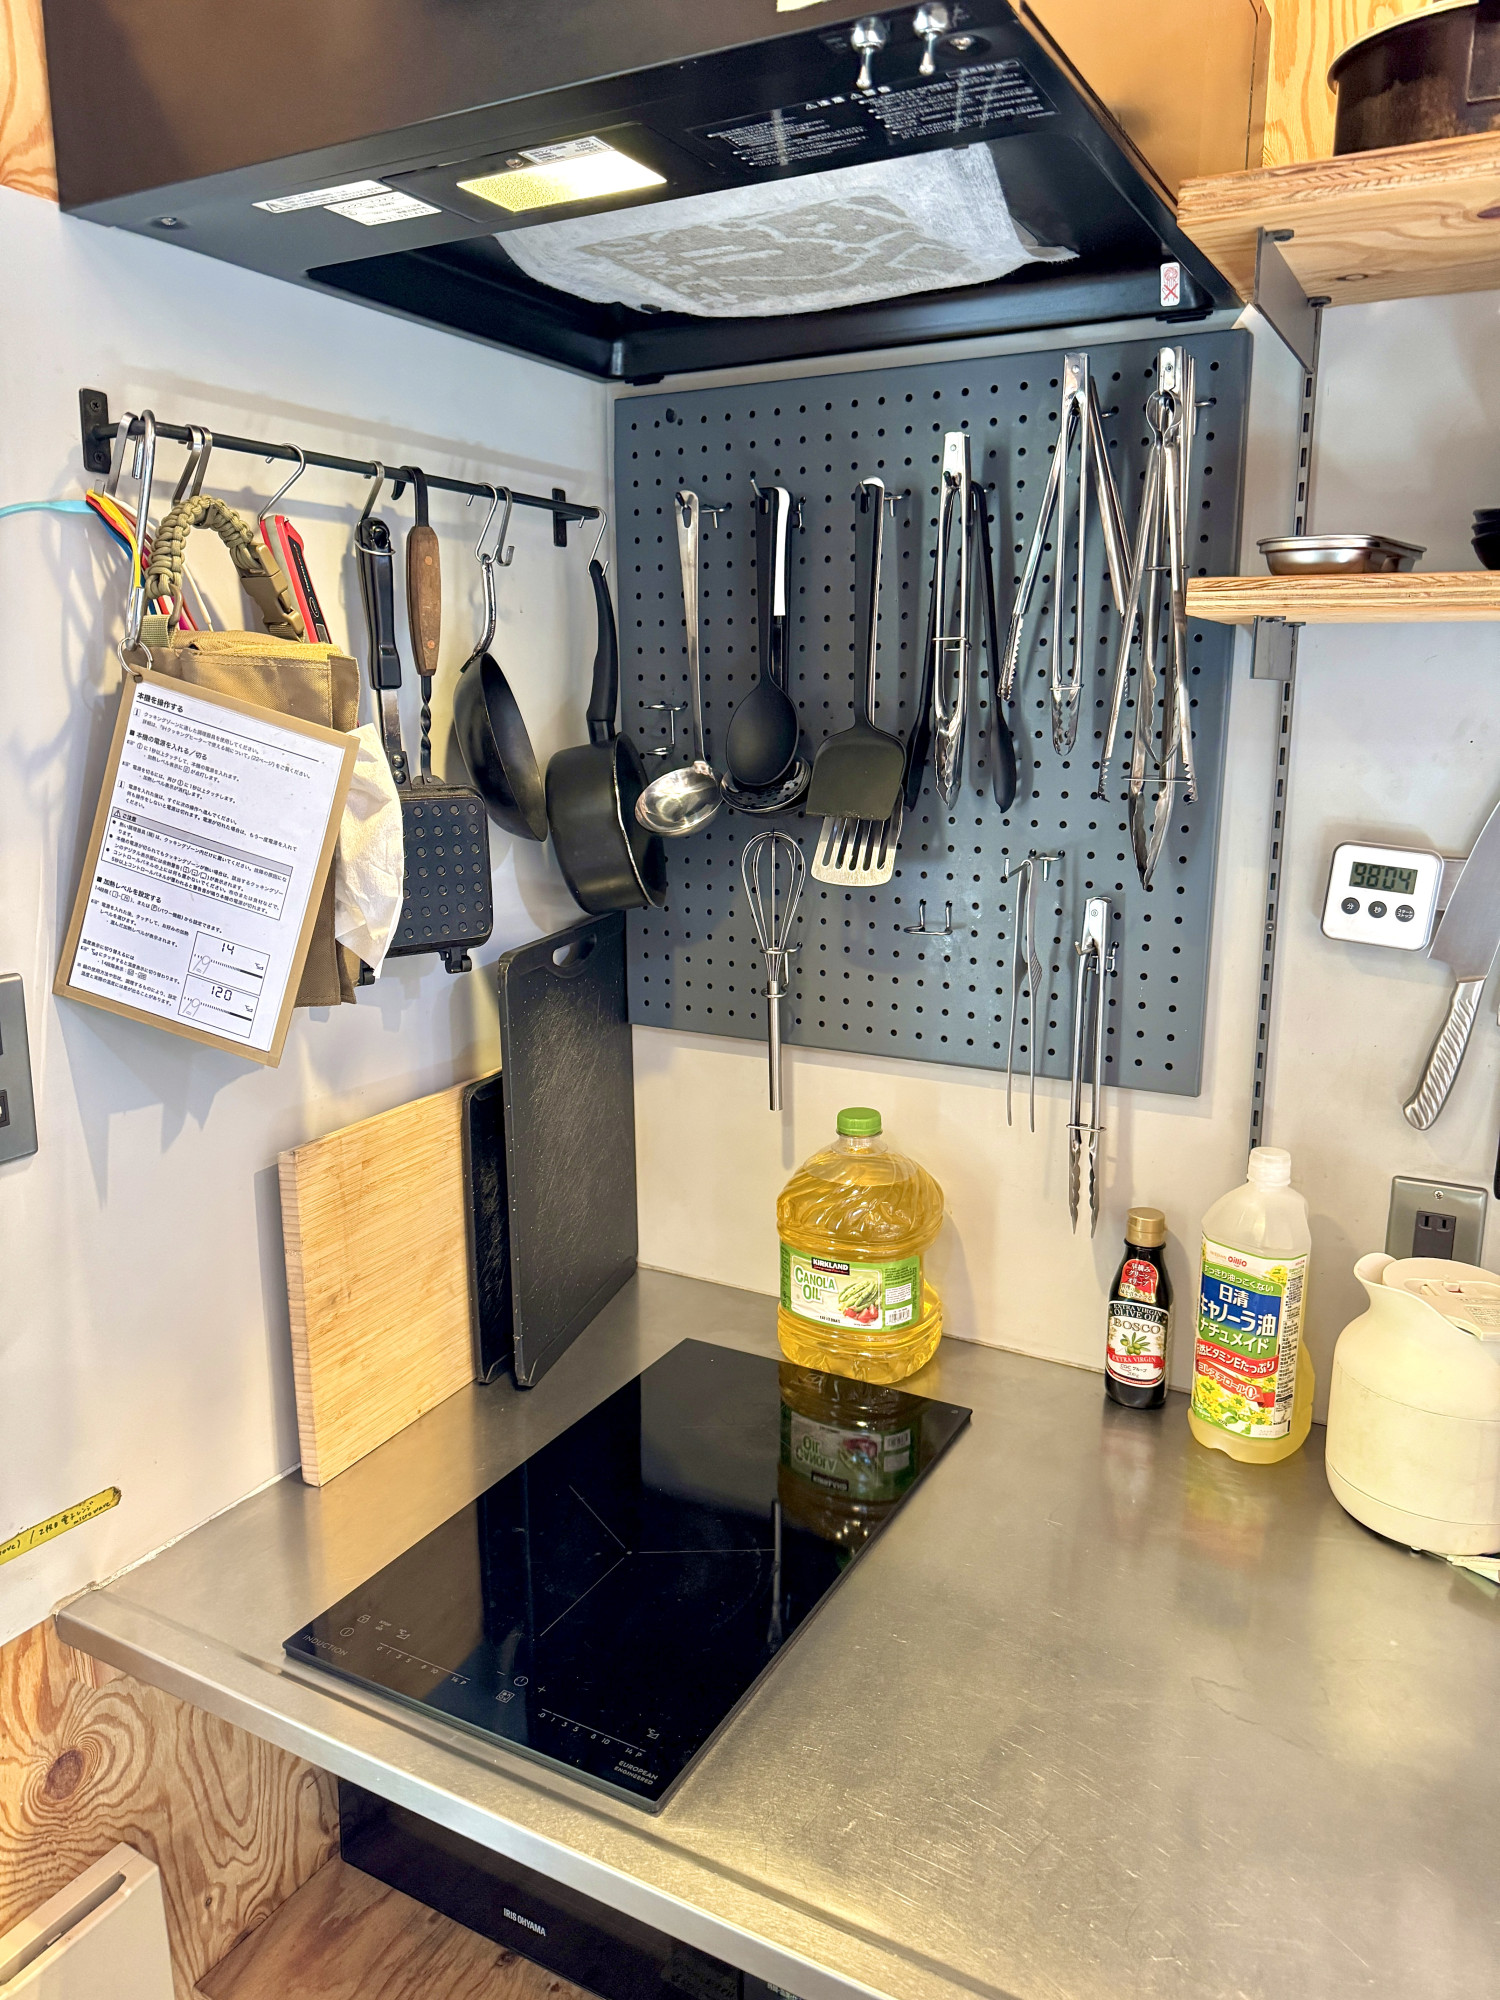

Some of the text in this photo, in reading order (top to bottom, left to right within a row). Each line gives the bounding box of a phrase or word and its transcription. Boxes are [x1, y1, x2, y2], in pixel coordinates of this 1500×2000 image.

[136, 691, 184, 713] 本機を操作する
[124, 798, 145, 809] ください。
[122, 813, 136, 822] ご注意
[102, 878, 162, 904] 加熱レベルを設定する
[221, 942, 234, 955] 14
[210, 984, 233, 1002] 120
[812, 1258, 848, 1271] KIRKLAND
[795, 1267, 836, 1290] CANOLA
[1204, 1265, 1274, 1292] すっきり油っこくない
[802, 1284, 820, 1301] OIL
[1219, 1284, 1250, 1308] 日清
[1114, 1308, 1160, 1323] OLIVE OIL
[1137, 1306, 1162, 1317] VIRGIN
[1200, 1292, 1276, 1336] キャノーラ油
[1113, 1317, 1160, 1334] BOSCO
[1200, 1318, 1270, 1354] ナチュメイド
[302, 1634, 348, 1656] INDUCTION
[614, 1766, 654, 1786] ENGINEERED
[618, 1760, 659, 1780] EUROPEAN
[503, 1908, 546, 1936] IRIS OHYAMA
